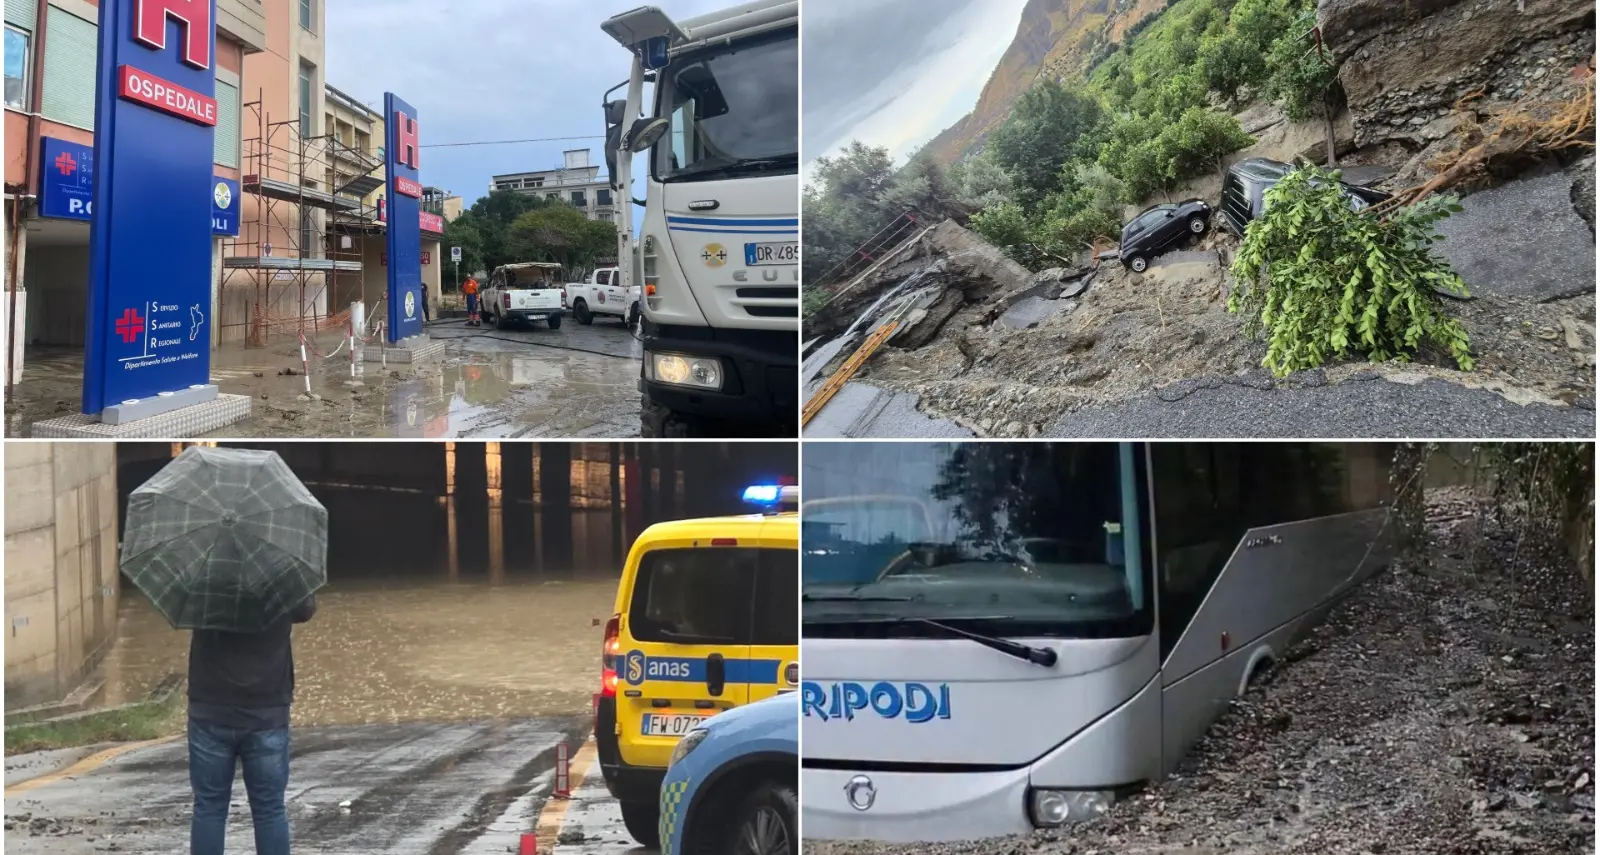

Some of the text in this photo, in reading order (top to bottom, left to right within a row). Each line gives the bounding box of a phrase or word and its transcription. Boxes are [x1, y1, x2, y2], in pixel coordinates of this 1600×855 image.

[133, 0, 210, 69] H
[128, 74, 214, 120] OSPEDALE
[396, 111, 419, 169] H
[756, 246, 774, 261] DR
[648, 660, 690, 677] anas
[802, 681, 952, 723] RIPODI
[651, 716, 668, 733] FW
